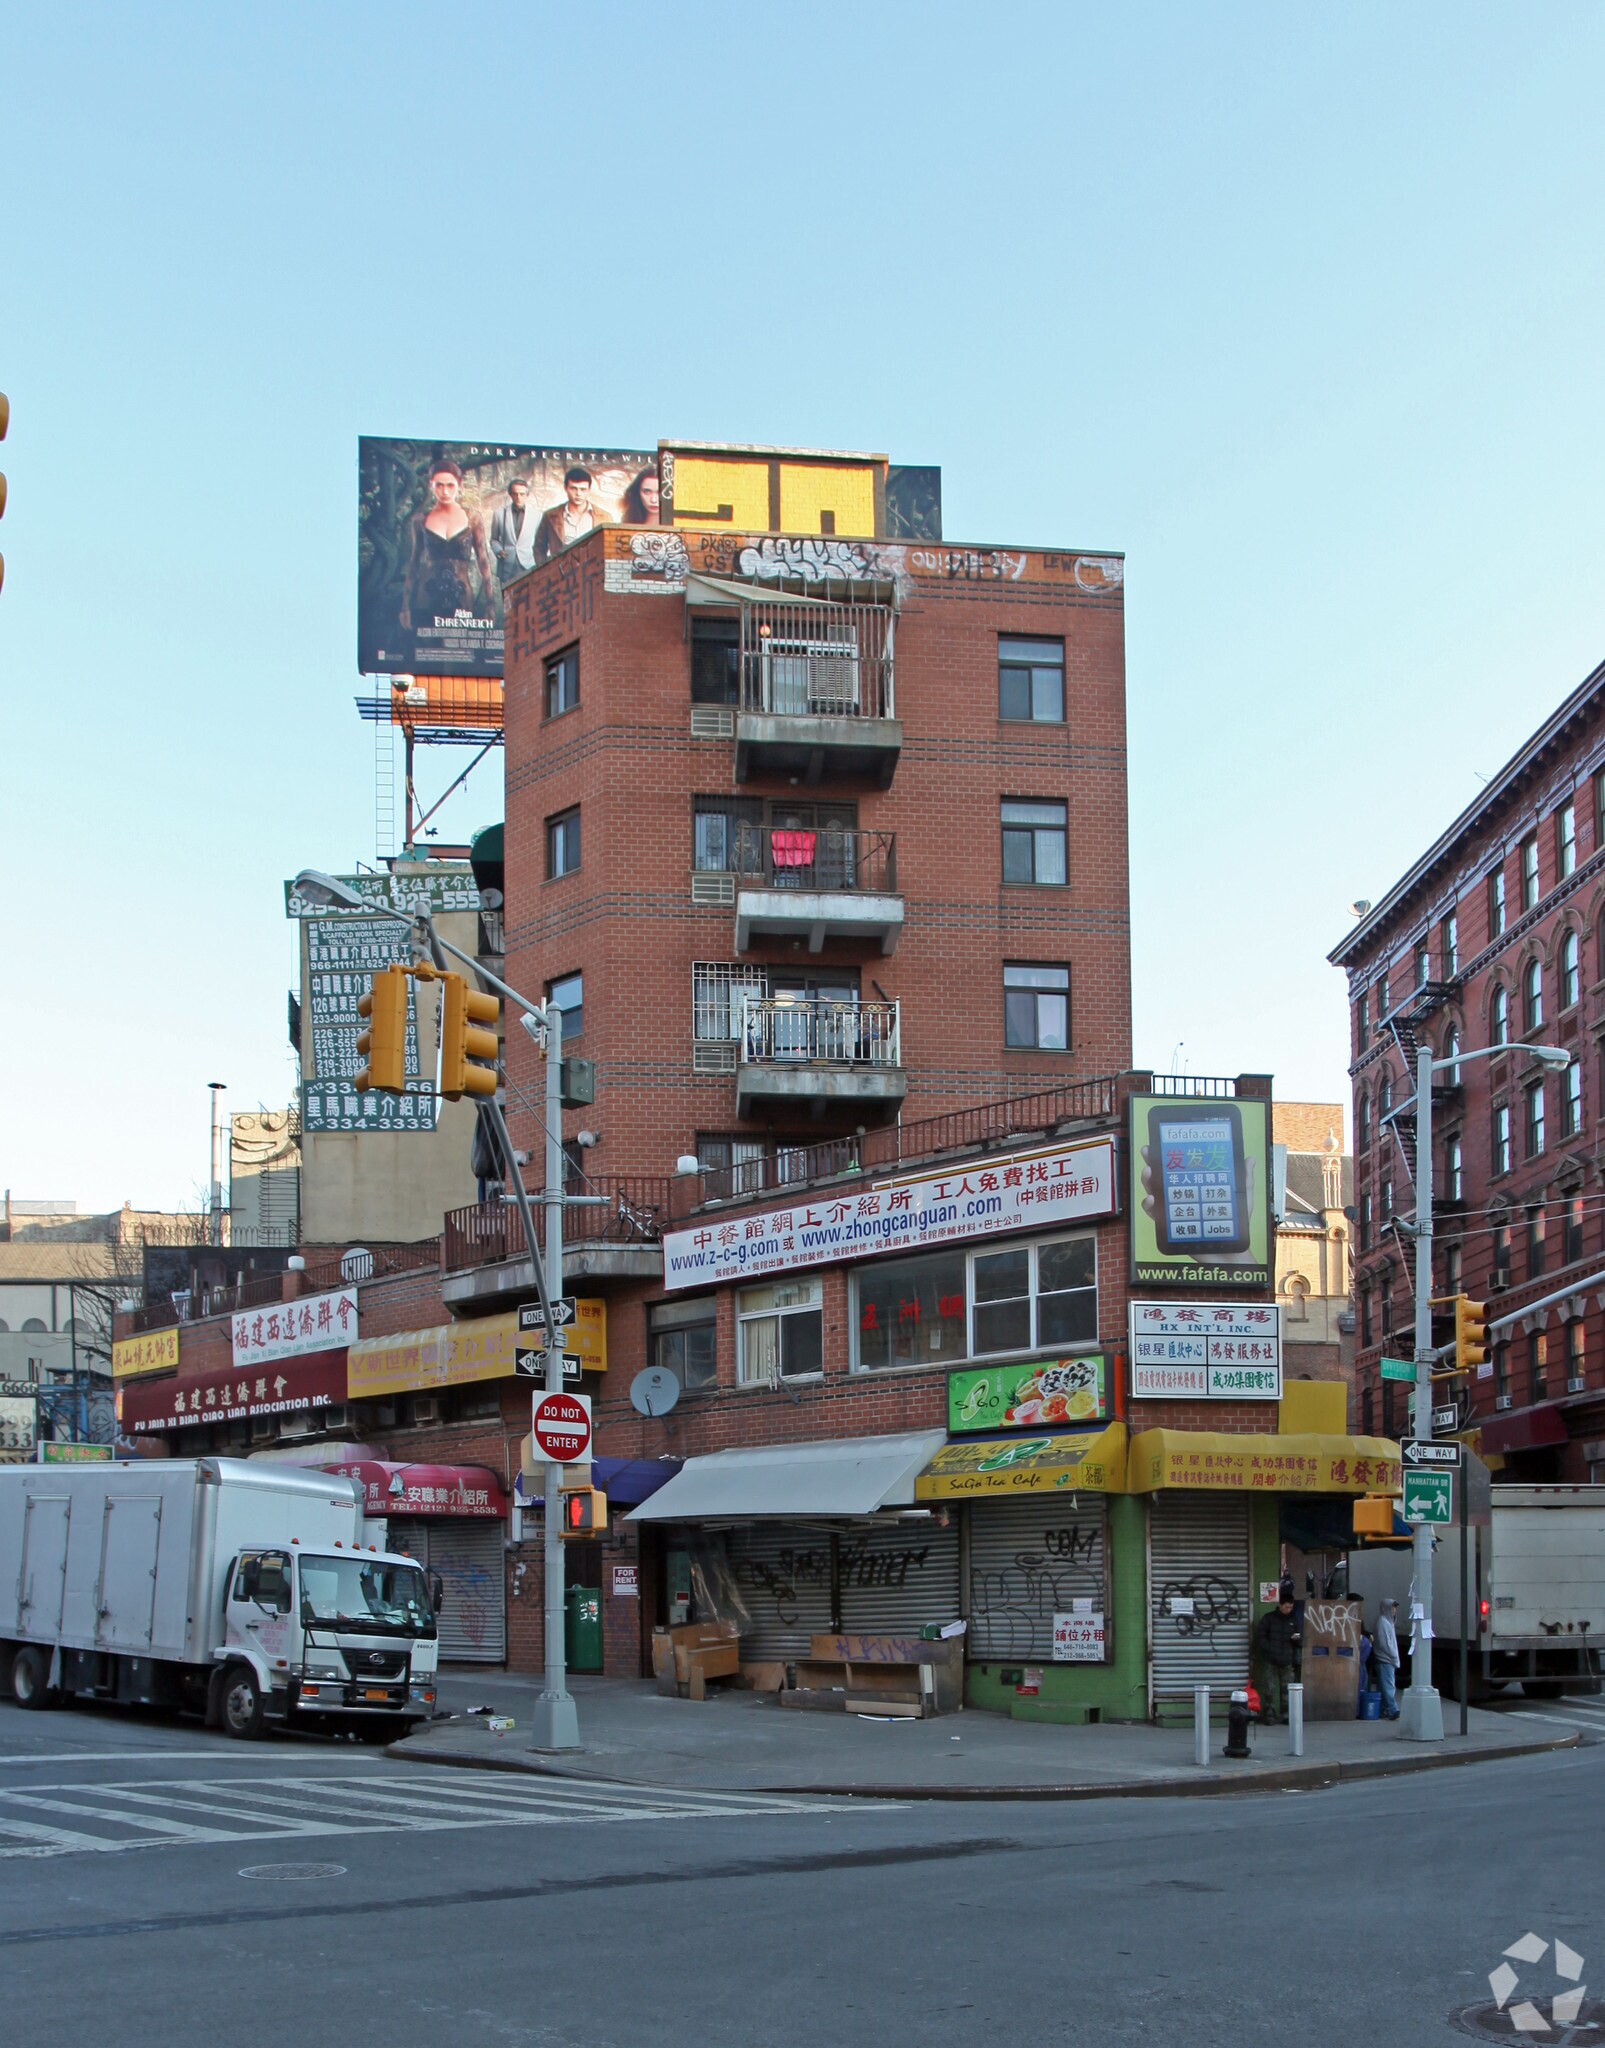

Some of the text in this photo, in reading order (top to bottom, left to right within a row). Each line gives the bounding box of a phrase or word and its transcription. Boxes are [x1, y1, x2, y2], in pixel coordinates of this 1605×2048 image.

[470, 446, 655, 463] DARK SECRETS WIL
[434, 616, 494, 629] EHRENREICH
[393, 891, 480, 911] 925-555
[375, 929, 404, 937] SPECIALT
[310, 960, 354, 970] 966-1111
[313, 1014, 357, 1024] 233-9000
[315, 1039, 357, 1048] 226-555
[316, 1049, 360, 1058] 343-222
[317, 1058, 365, 1068] 219-3000
[317, 1067, 360, 1078] 334-666
[307, 1083, 324, 1093] 212
[307, 1095, 431, 1117] 星馬職業介紹所
[307, 1118, 433, 1129] 212 334-3333
[1168, 1128, 1225, 1139] fafafa.com
[1166, 1144, 1226, 1170] 发发发
[1169, 1173, 1228, 1184] 华人招聘网
[1173, 1189, 1195, 1200] 炒锅
[694, 1158, 1073, 1250] 中餐館網上介紹所 工人免費找工
[1174, 1205, 1228, 1218] 企台 外卖
[1176, 1224, 1197, 1236] 收银
[1207, 1225, 1231, 1235] Jobs
[671, 1237, 779, 1272] www.z-c-g.com
[783, 1235, 795, 1251] 或
[1137, 1267, 1268, 1283] www.fafafa.com
[526, 1311, 542, 1322] ONE
[1160, 1323, 1255, 1334] HX INT'L INC.
[134, 1394, 332, 1431] FU JAIN XI BIAN QIAO LIAN ASSOCIATION INC.
[543, 1405, 580, 1419] DO NOT
[1436, 1413, 1450, 1424] WAY
[546, 1436, 578, 1449] ENTER
[1410, 1447, 1453, 1458] ONE WAY
[950, 1474, 1042, 1490] SaGo Tea Cafe
[1407, 1477, 1448, 1487] MANHATTAN BR
[390, 1503, 416, 1511] TEL:
[615, 1576, 637, 1584] RENT
